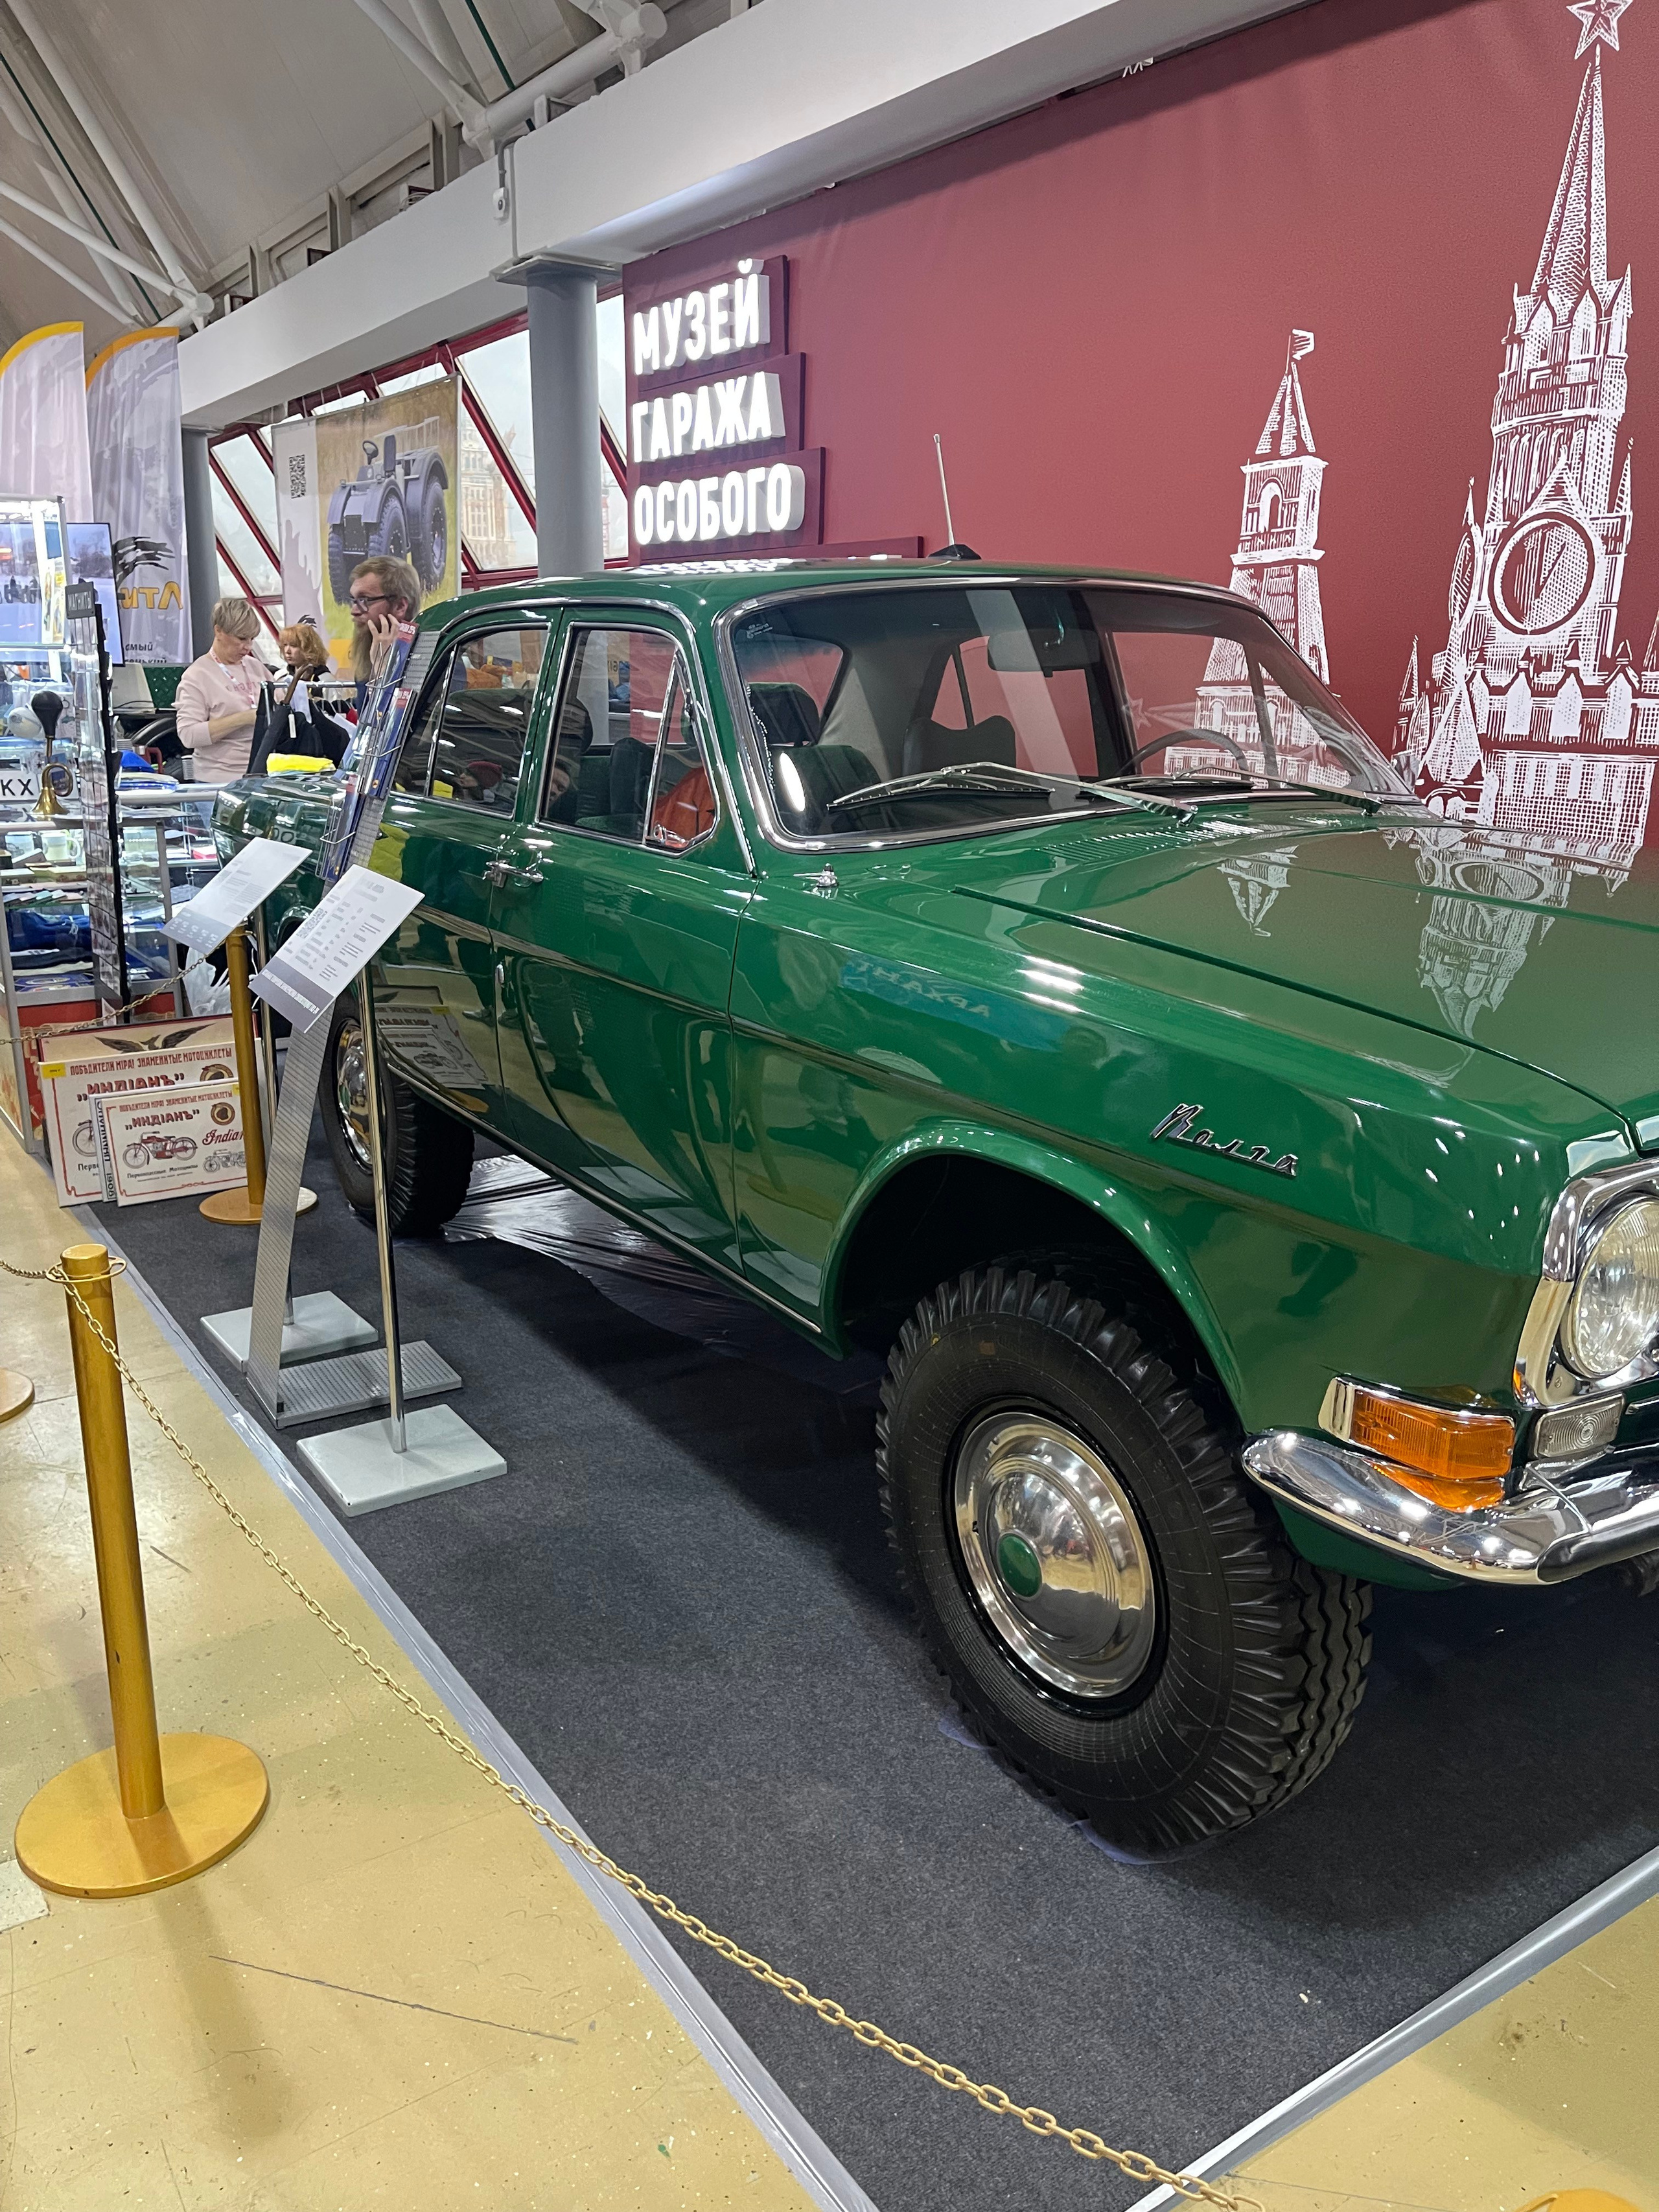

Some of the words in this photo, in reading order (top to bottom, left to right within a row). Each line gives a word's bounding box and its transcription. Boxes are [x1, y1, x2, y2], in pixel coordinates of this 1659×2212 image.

[632, 258, 765, 376] МУЗЕЙ
[632, 371, 780, 463] ГАРАЖА
[633, 463, 799, 545] ОСОБОГО
[137, 1052, 183, 1069] ЗНАМЕНИТЫЕ
[183, 1047, 232, 1063] МОТОЦИКЛЕТЫ
